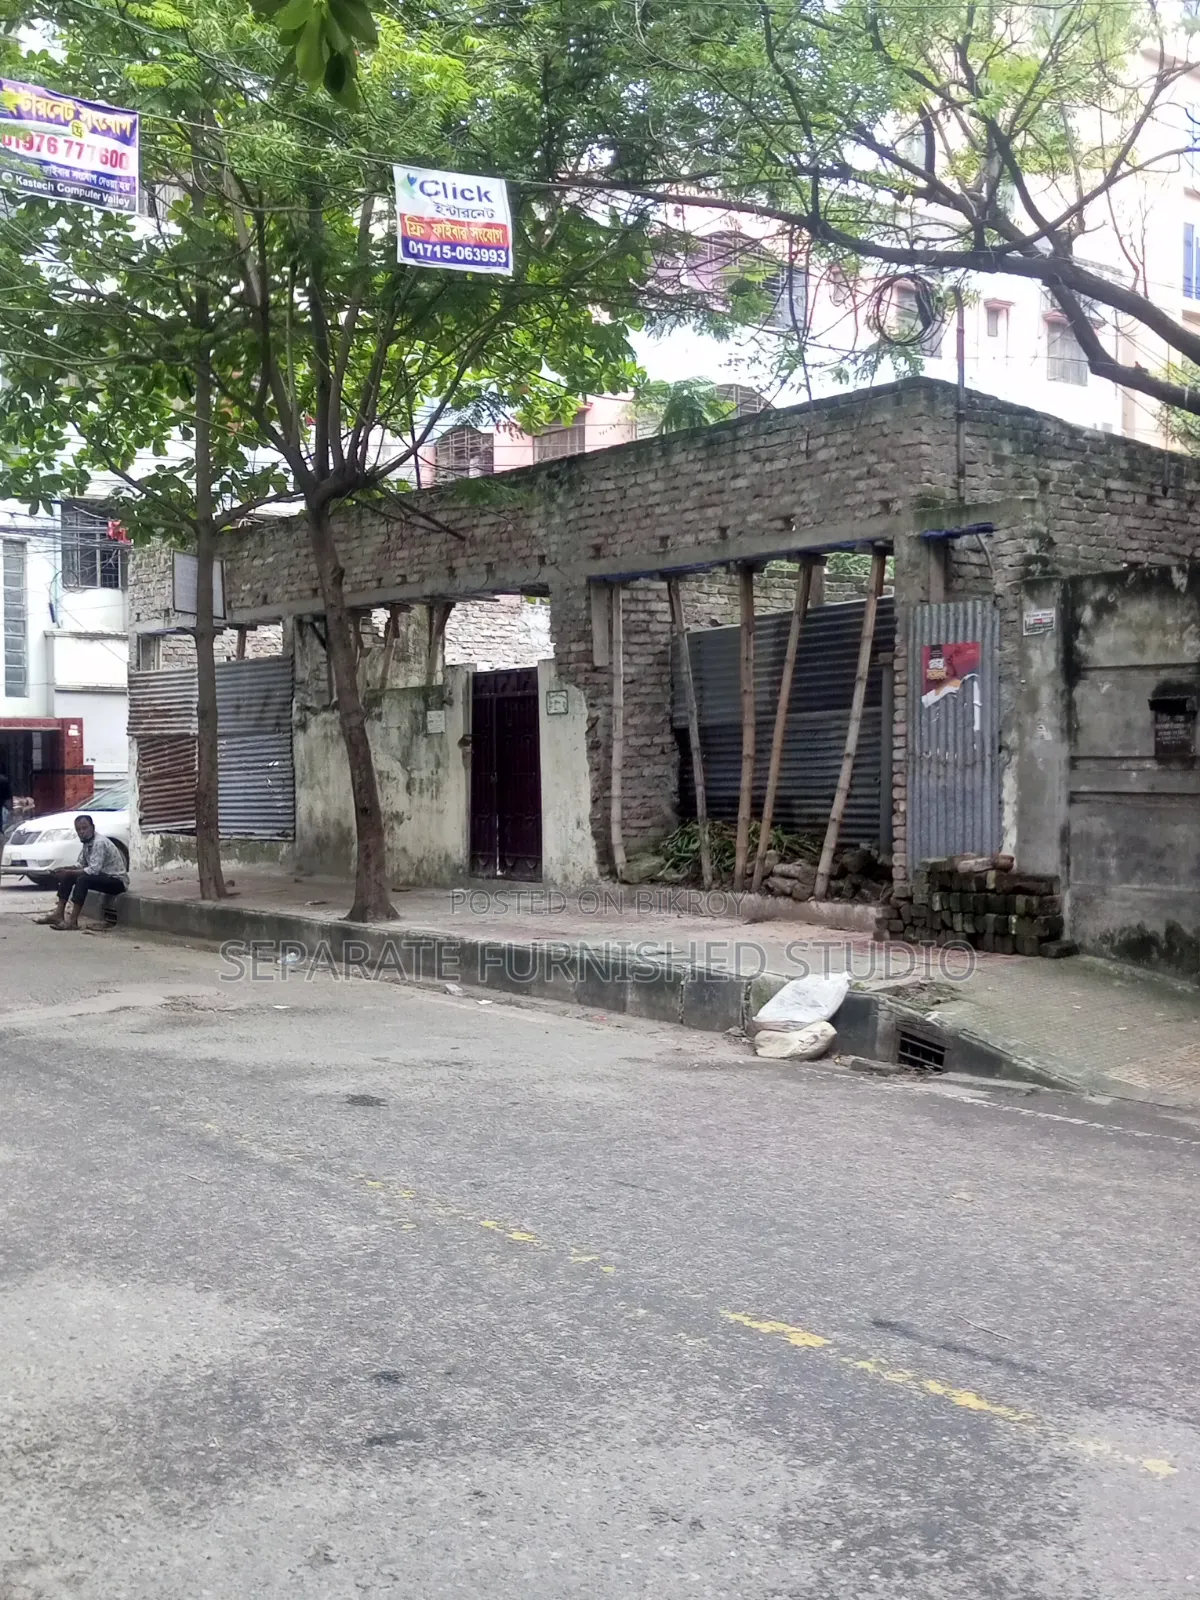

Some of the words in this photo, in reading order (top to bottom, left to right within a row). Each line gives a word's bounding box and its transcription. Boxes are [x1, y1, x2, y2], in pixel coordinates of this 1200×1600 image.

[15, 174, 55, 192] Kastech
[56, 182, 101, 201] Computer
[419, 179, 494, 204] Click
[433, 200, 495, 219] ইন্টারনেট
[430, 220, 467, 240] ফাইবার
[468, 226, 504, 244] সংযোগ
[408, 240, 507, 263] 01715-063993
